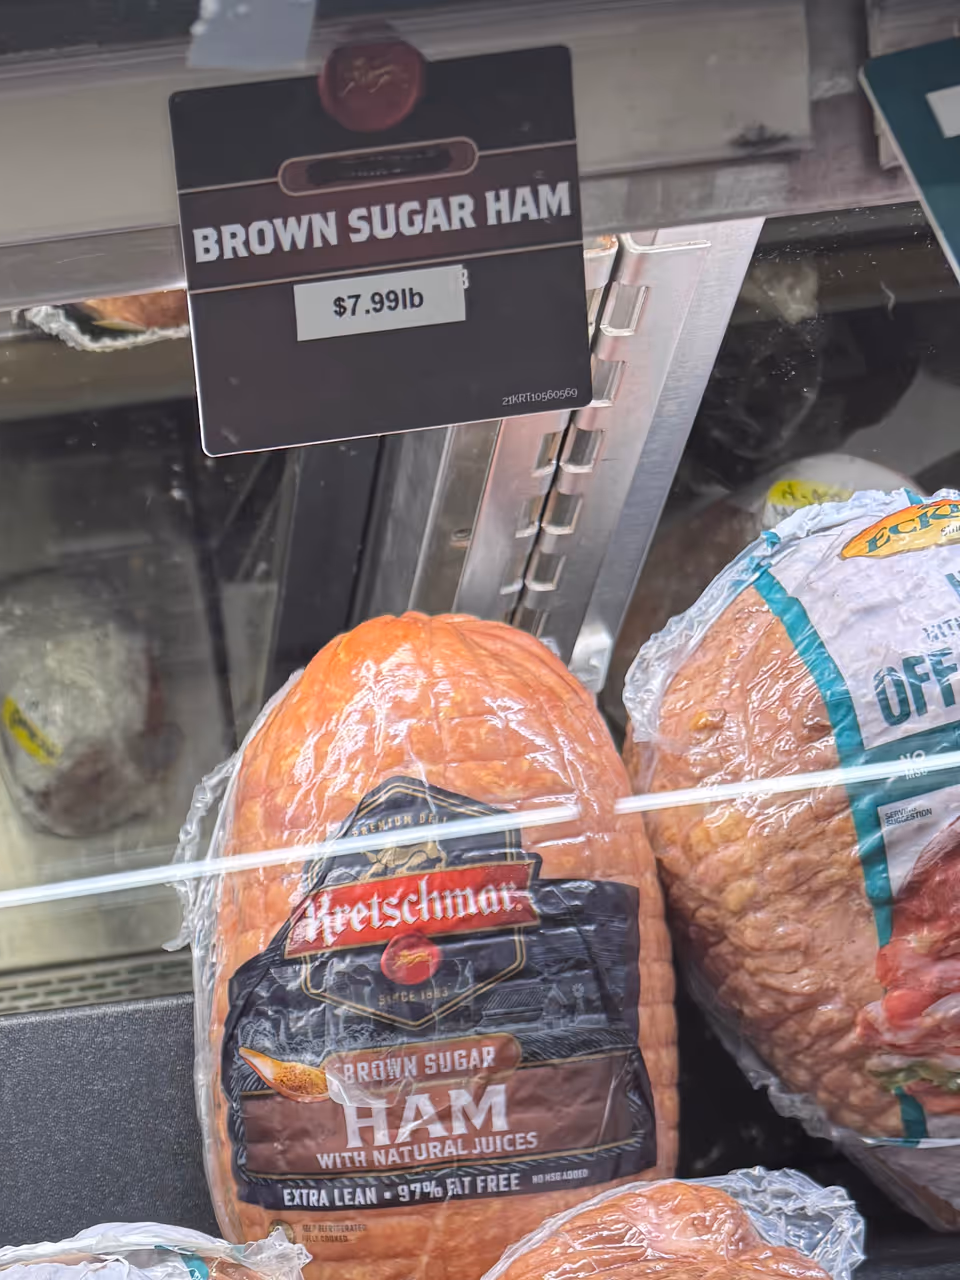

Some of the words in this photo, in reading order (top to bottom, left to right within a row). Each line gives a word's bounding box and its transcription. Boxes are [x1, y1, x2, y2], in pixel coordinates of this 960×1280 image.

[192, 211, 338, 263] BROWN
[348, 194, 477, 243] SUGAR
[485, 181, 572, 226] HAM
[333, 286, 424, 318] $7.99lb
[865, 503, 960, 553] ECK
[873, 647, 958, 727] OFF
[305, 874, 518, 948] Kretschmar
[342, 1055, 417, 1085] BROWN
[424, 1046, 496, 1073] SUGAR
[341, 1084, 510, 1149] HAM
[316, 1150, 368, 1169] WITH
[373, 1139, 471, 1167] NATURAL
[473, 1131, 539, 1152] JUICES
[283, 1188, 328, 1207] EXTRA
[333, 1186, 377, 1206] LEAN
[398, 1179, 442, 1201] 97%
[445, 1175, 472, 1197] FAT
[477, 1173, 521, 1192] FREE
